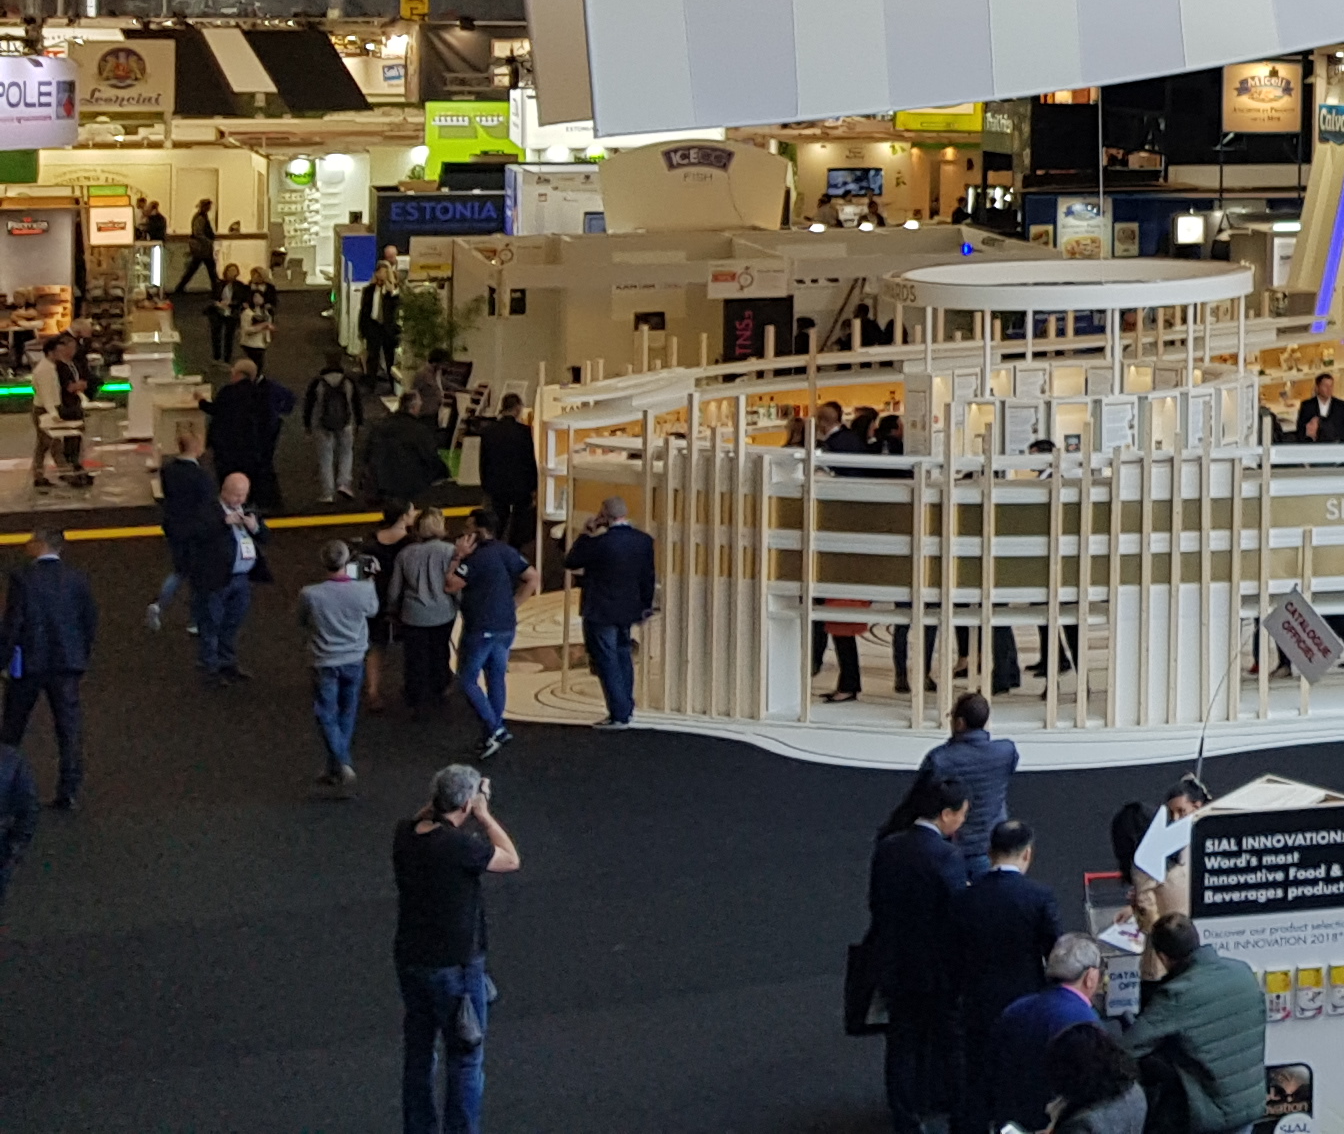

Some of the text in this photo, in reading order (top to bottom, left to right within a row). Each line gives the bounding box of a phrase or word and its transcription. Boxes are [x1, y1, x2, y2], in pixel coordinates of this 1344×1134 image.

[683, 173, 713, 183] FISH
[390, 201, 498, 222] ESTONIA
[1284, 601, 1332, 659] CATALOGUE
[1281, 620, 1315, 663] OFFICIEL
[1204, 837, 1239, 853] SIAL
[1204, 850, 1300, 870] Word's most
[1204, 863, 1344, 887] innovative Food &
[1203, 887, 1285, 905] Beverages
[1203, 928, 1246, 940] Discover
[1249, 927, 1267, 937] our
[1269, 922, 1308, 938] product
[1213, 941, 1231, 952] IAL
[1233, 937, 1307, 951] INNOVATION
